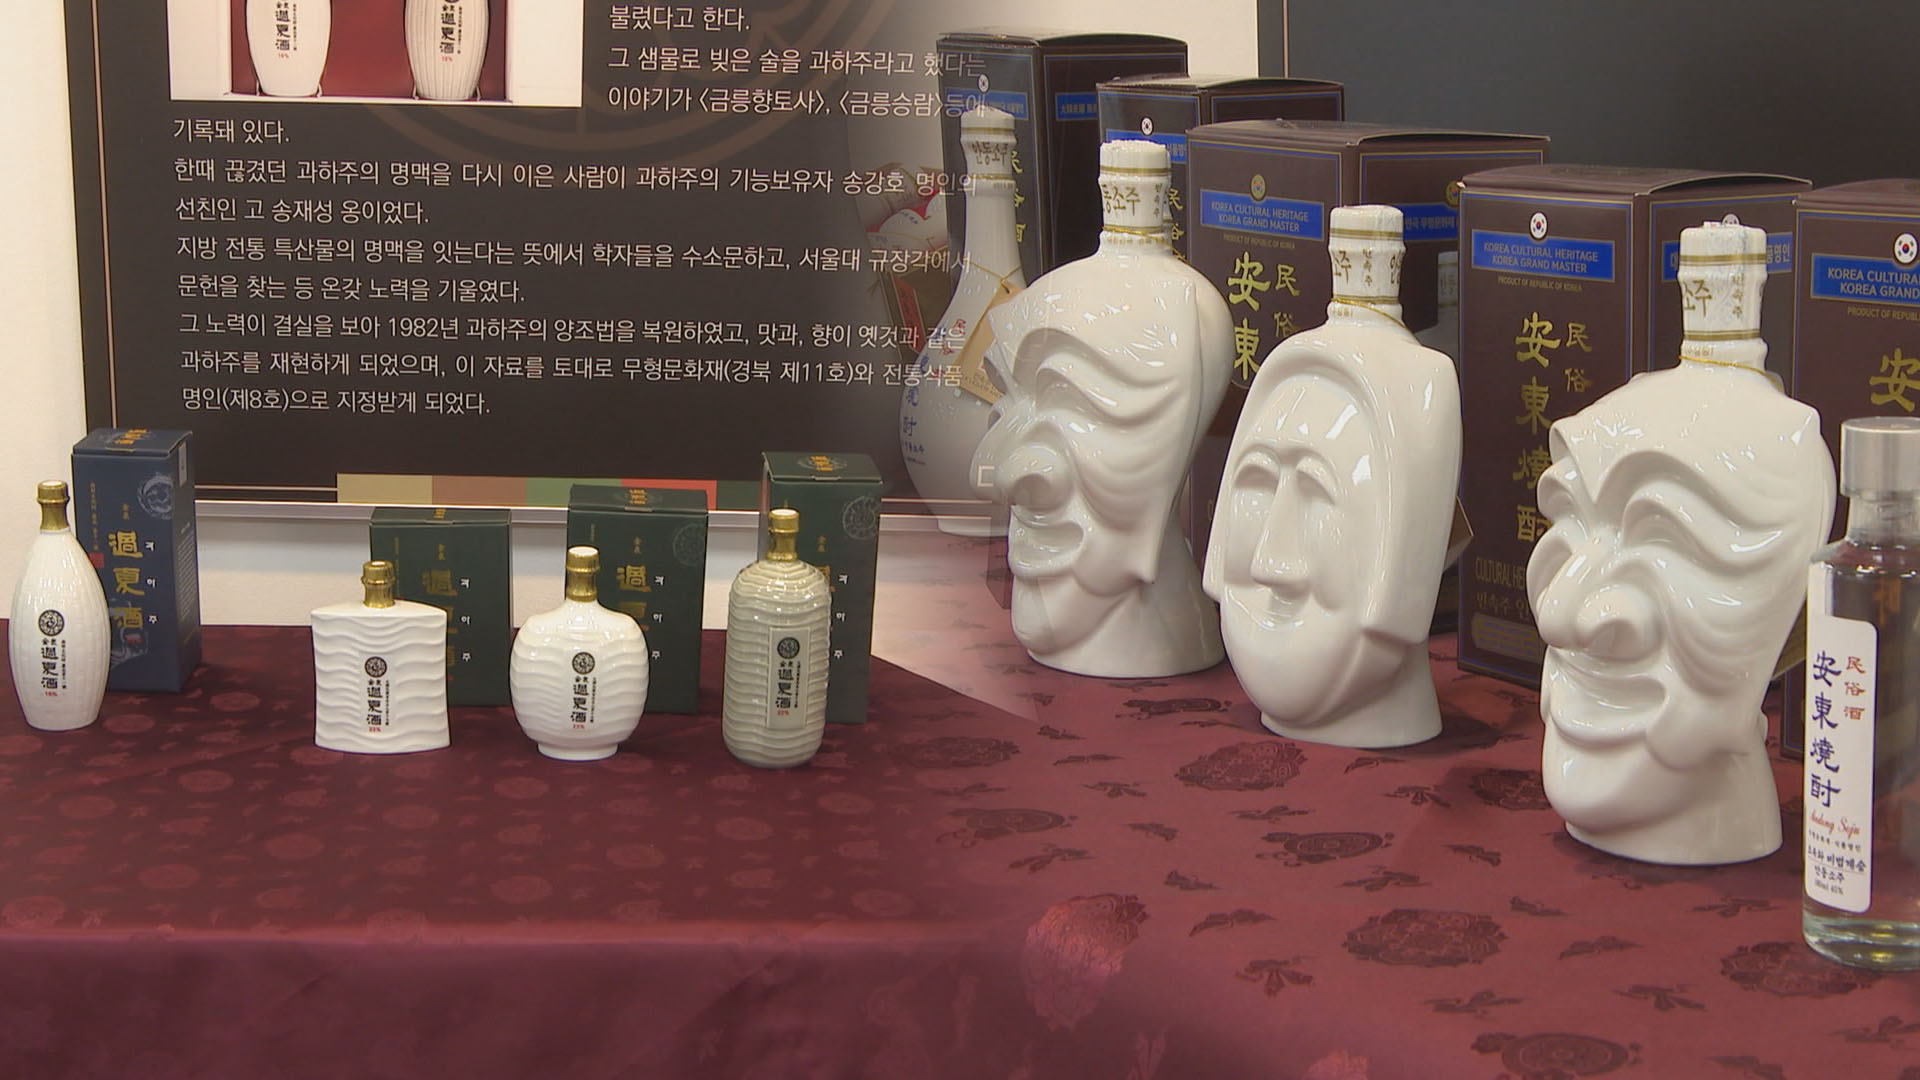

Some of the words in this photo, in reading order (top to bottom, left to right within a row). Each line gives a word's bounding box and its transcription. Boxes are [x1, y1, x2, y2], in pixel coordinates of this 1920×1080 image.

[703, 7, 750, 32] 한다.
[609, 48, 629, 67] 그
[638, 47, 700, 71] 샘물로
[711, 48, 751, 72] 빚은
[759, 49, 801, 73] 술을
[810, 50, 914, 75] 과하주라고
[925, 52, 987, 77] 했다는
[609, 87, 692, 111] 이야기가
[174, 119, 234, 143] 기록돼
[243, 120, 289, 144] 있다.
[175, 158, 214, 182] 한때
[297, 160, 378, 184] 과하주의
[391, 162, 451, 186] 명맥을
[463, 163, 501, 187] 다시
[514, 164, 554, 187] 이은
[564, 165, 624, 189] 사람이
[636, 166, 718, 191] 과하주의
[730, 168, 833, 193] 기능보유자
[843, 171, 904, 194] 송강호
[917, 173, 977, 196] 명인의
[176, 198, 236, 220] 선친인
[244, 200, 264, 218] 고
[272, 199, 332, 223] 송재성
[341, 200, 428, 224] 옹이었다.
[1211, 201, 1234, 213] KOREA
[1235, 204, 1270, 217] CULTURAL
[1272, 208, 1309, 222] HERITAGE
[1219, 213, 1242, 226] KOREA
[1242, 216, 1269, 229] GRAND
[1270, 219, 1300, 232] MASTER
[178, 236, 217, 259] 지방
[226, 237, 265, 260] 전통
[274, 238, 354, 262] 특산물의
[365, 240, 424, 263] 명맥을
[433, 241, 514, 264] 잇는다는
[523, 243, 582, 266] 뜻에서
[593, 244, 674, 267] 학자들을
[682, 246, 789, 270] 수소문하고,
[799, 248, 860, 272] 서울대
[869, 250, 971, 274] 규장각에서
[1484, 242, 1510, 254] KOREA
[1511, 244, 1553, 258] CULTURAL
[1555, 248, 1599, 262] HERITAGE
[1492, 254, 1519, 266] KOREA
[1520, 257, 1549, 270] GRAND
[1551, 260, 1587, 273] MASTER
[178, 275, 239, 297] 문헌을
[247, 276, 286, 298] 찾는
[294, 277, 313, 299] 등
[321, 277, 362, 300] 온갖
[369, 279, 430, 301] 노력을
[439, 280, 524, 303] 기울였다.
[1828, 267, 1864, 281] KOREA
[1867, 270, 1920, 285] CULTURA
[1840, 283, 1877, 296] KOREA
[1880, 284, 1920, 300] GRAND
[1227, 251, 1270, 381] 安東
[1847, 306, 1880, 318] PRODUCT
[1881, 308, 1890, 319] OF
[180, 314, 199, 332] 그
[206, 313, 265, 336] 노력이
[274, 314, 333, 337] 결실을
[340, 316, 380, 339] 보아
[389, 317, 458, 339] 1982년
[466, 318, 546, 341] 과하주의
[554, 320, 635, 342] 양조법을
[642, 321, 748, 345] 복원하였고,
[759, 323, 802, 346] 맛과,
[812, 324, 850, 347] 향이
[859, 326, 919, 348] 옛것과
[927, 325, 966, 349] 같은
[181, 350, 261, 373] 과하주를
[270, 352, 349, 375] 재현하게
[360, 354, 445, 377] 되었으며,
[456, 355, 473, 378] 이
[484, 356, 544, 378] 자료를
[553, 357, 613, 380] 토대로
[622, 358, 771, 383] 무형문화재(경북
[780, 361, 874, 385] 제11호)와
[883, 364, 962, 387] 전통식품
[1565, 322, 1593, 393] 民俗
[1869, 347, 1920, 412] 安
[183, 387, 329, 412] 명인(제8호)으로
[337, 391, 416, 413] 지정받게
[425, 392, 490, 415] 되었다.
[108, 531, 145, 629] 過夏酒
[1843, 655, 1867, 721] 民俗酒
[1810, 651, 1842, 808] 安東燒酎
